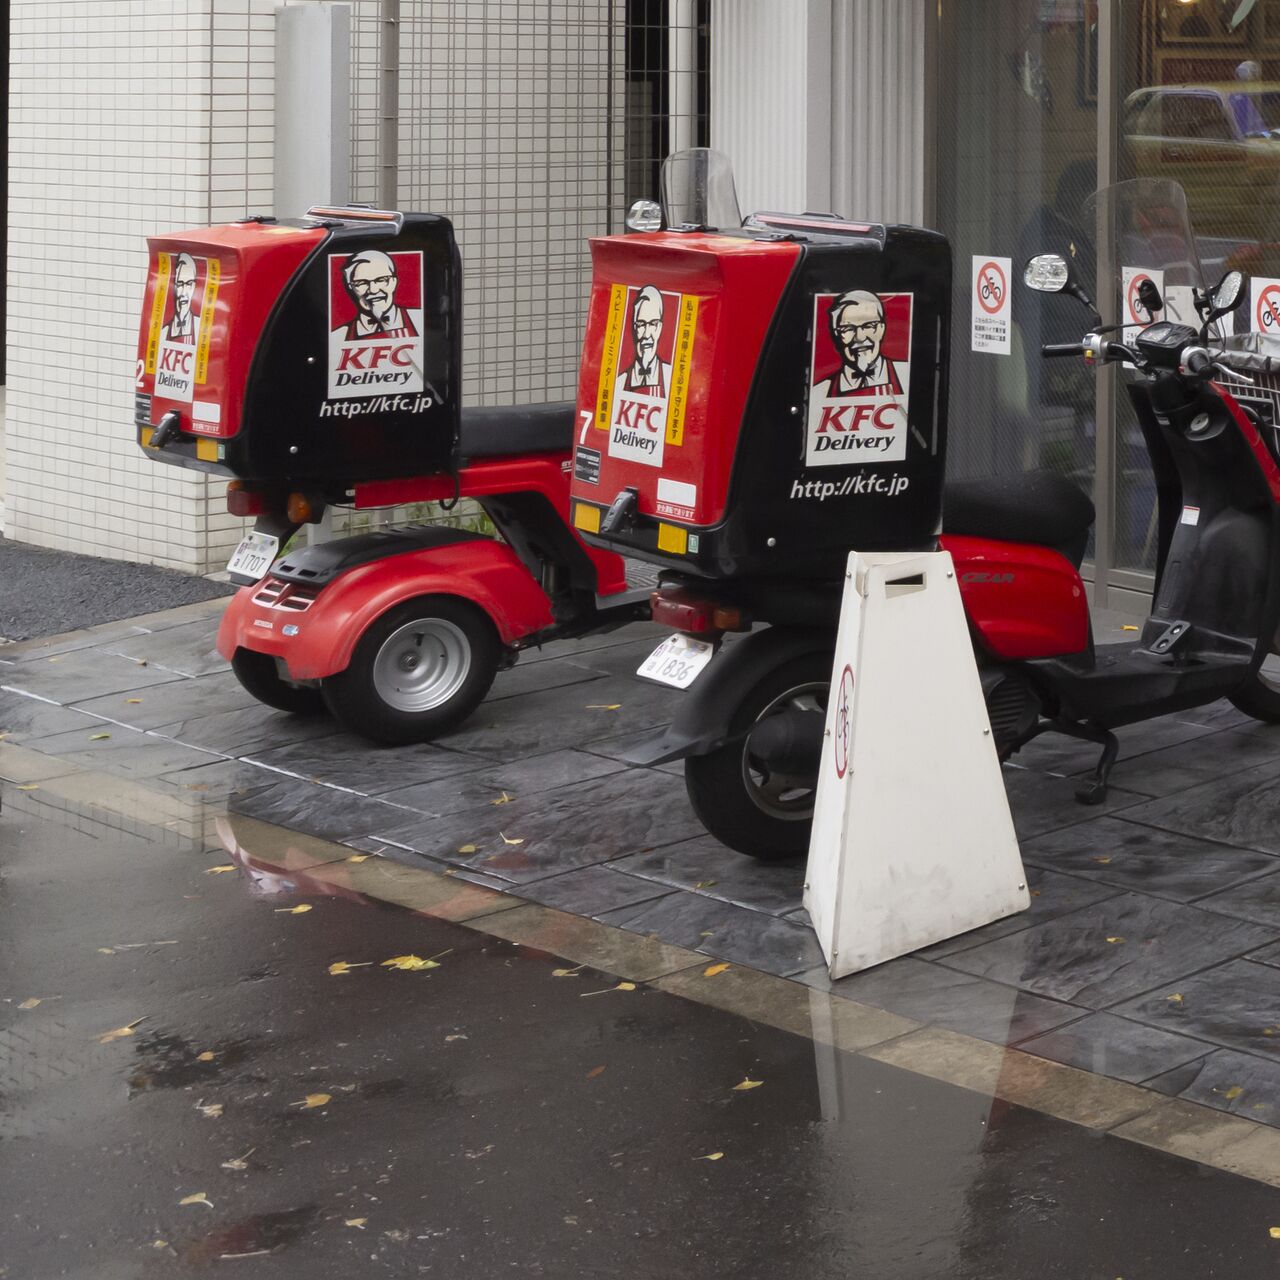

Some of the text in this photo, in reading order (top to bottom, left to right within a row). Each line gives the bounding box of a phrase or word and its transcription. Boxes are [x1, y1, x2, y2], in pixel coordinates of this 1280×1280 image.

[160, 348, 193, 375] KFC
[335, 343, 415, 371] KFC
[136, 359, 145, 388] 2
[157, 371, 189, 394] Delivery
[334, 370, 413, 387] Delivery
[319, 393, 433, 419] http://kfc.jp
[614, 399, 663, 433] KFC
[814, 402, 900, 434] KFC
[579, 410, 594, 445] 7
[612, 427, 658, 455] Delivery
[813, 433, 896, 453] Delivery
[790, 473, 909, 502] http://kfc.jp
[240, 553, 267, 573] 1707
[656, 657, 696, 681] 1836
